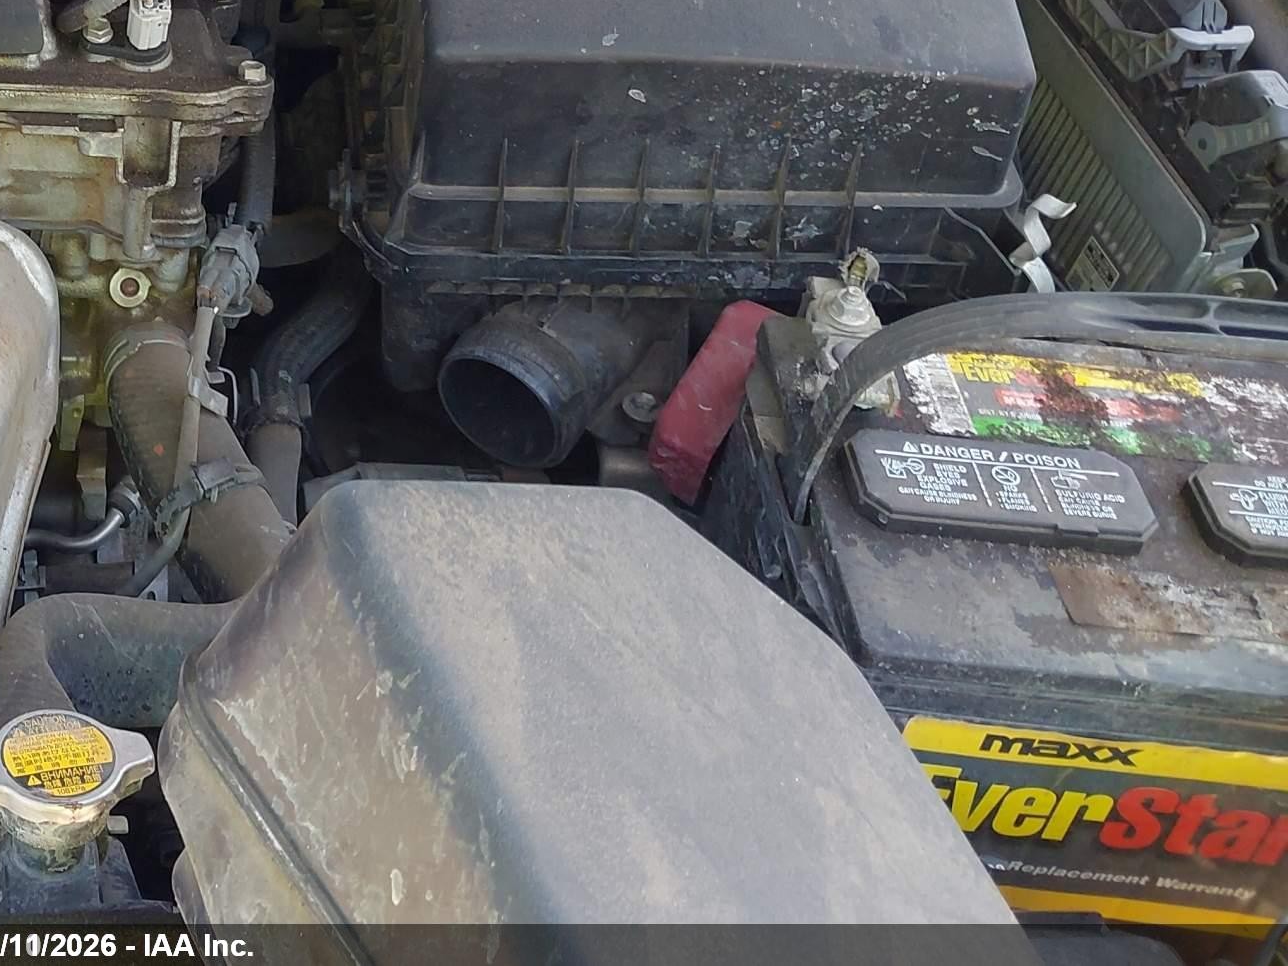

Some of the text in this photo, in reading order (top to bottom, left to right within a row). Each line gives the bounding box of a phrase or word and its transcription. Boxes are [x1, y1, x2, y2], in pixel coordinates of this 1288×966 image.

[920, 443, 995, 461] DANGER
[1012, 452, 1081, 469] POISON
[933, 462, 967, 473] SHIELD
[917, 474, 968, 487] EXPLOSIVE
[979, 732, 1143, 767] maxx
[1007, 859, 1258, 901] Replacement Warranty
